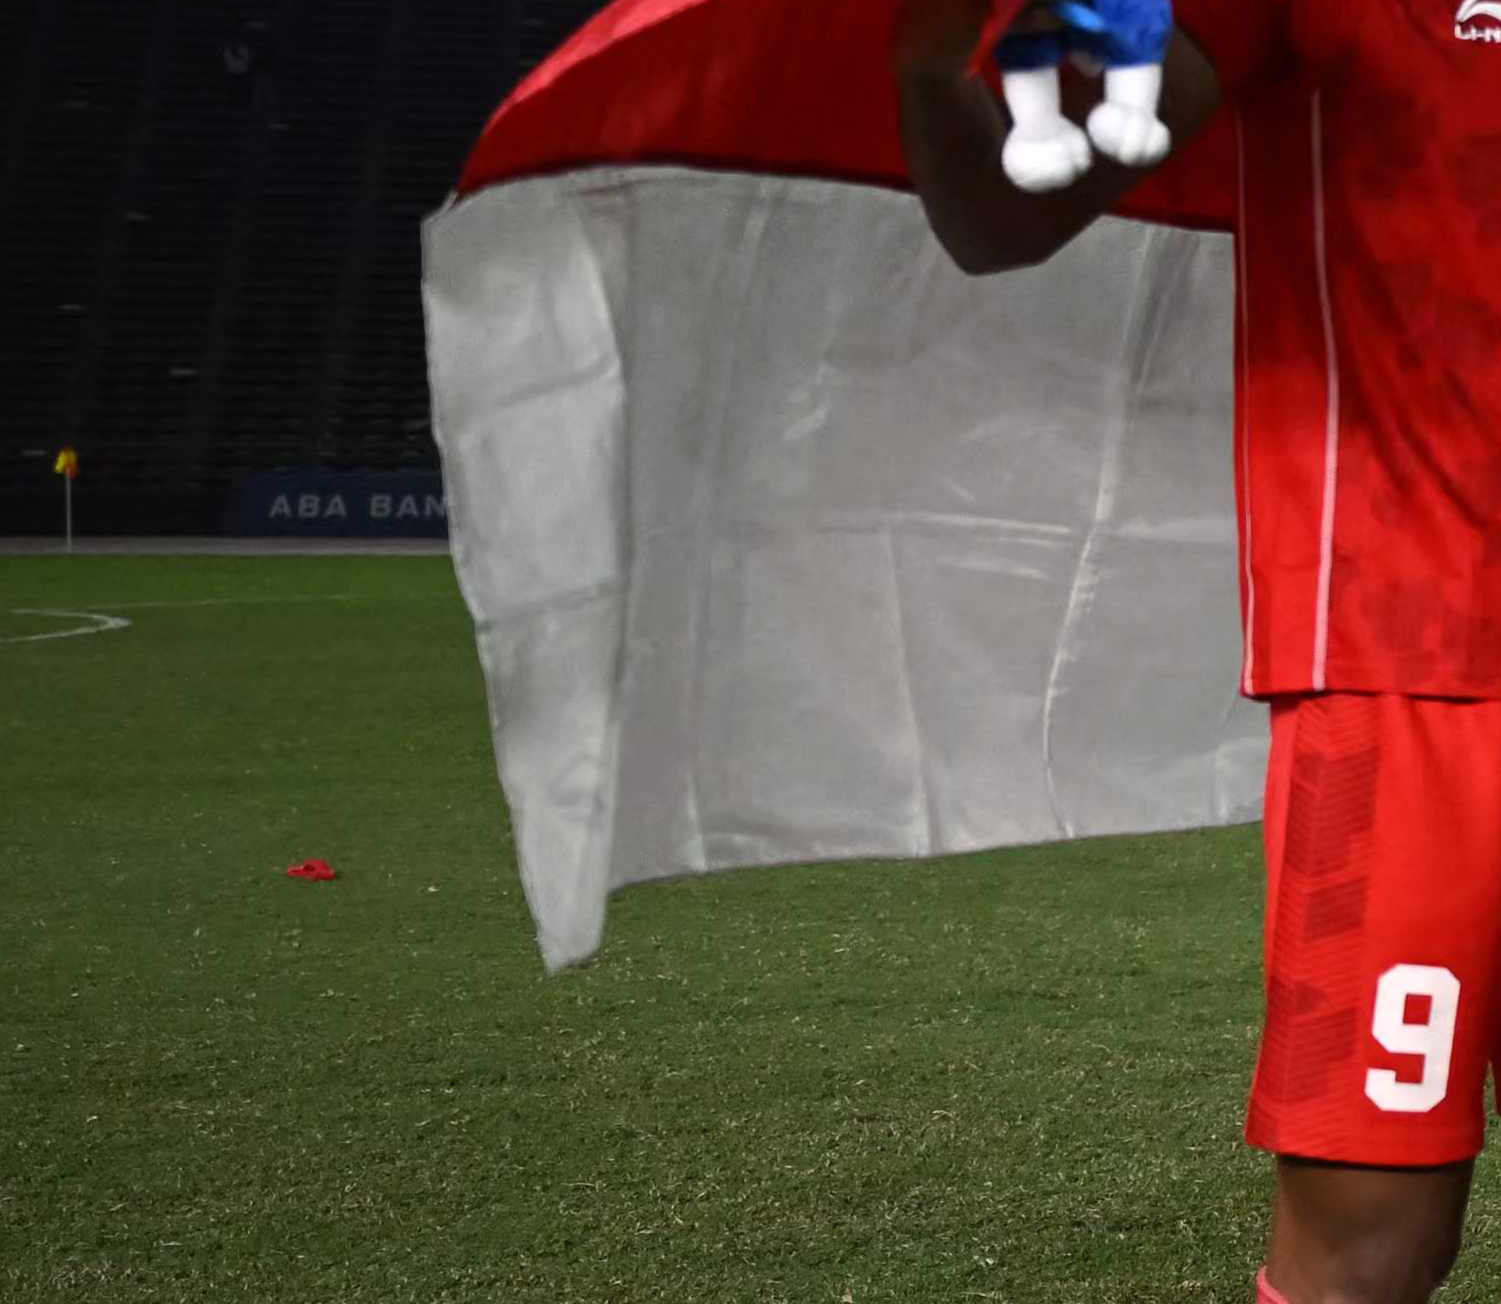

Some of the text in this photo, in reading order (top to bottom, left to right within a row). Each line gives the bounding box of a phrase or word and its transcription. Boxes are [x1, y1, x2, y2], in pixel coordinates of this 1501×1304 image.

[268, 494, 449, 519] ABA BAN
[1364, 962, 1461, 1113] 9
